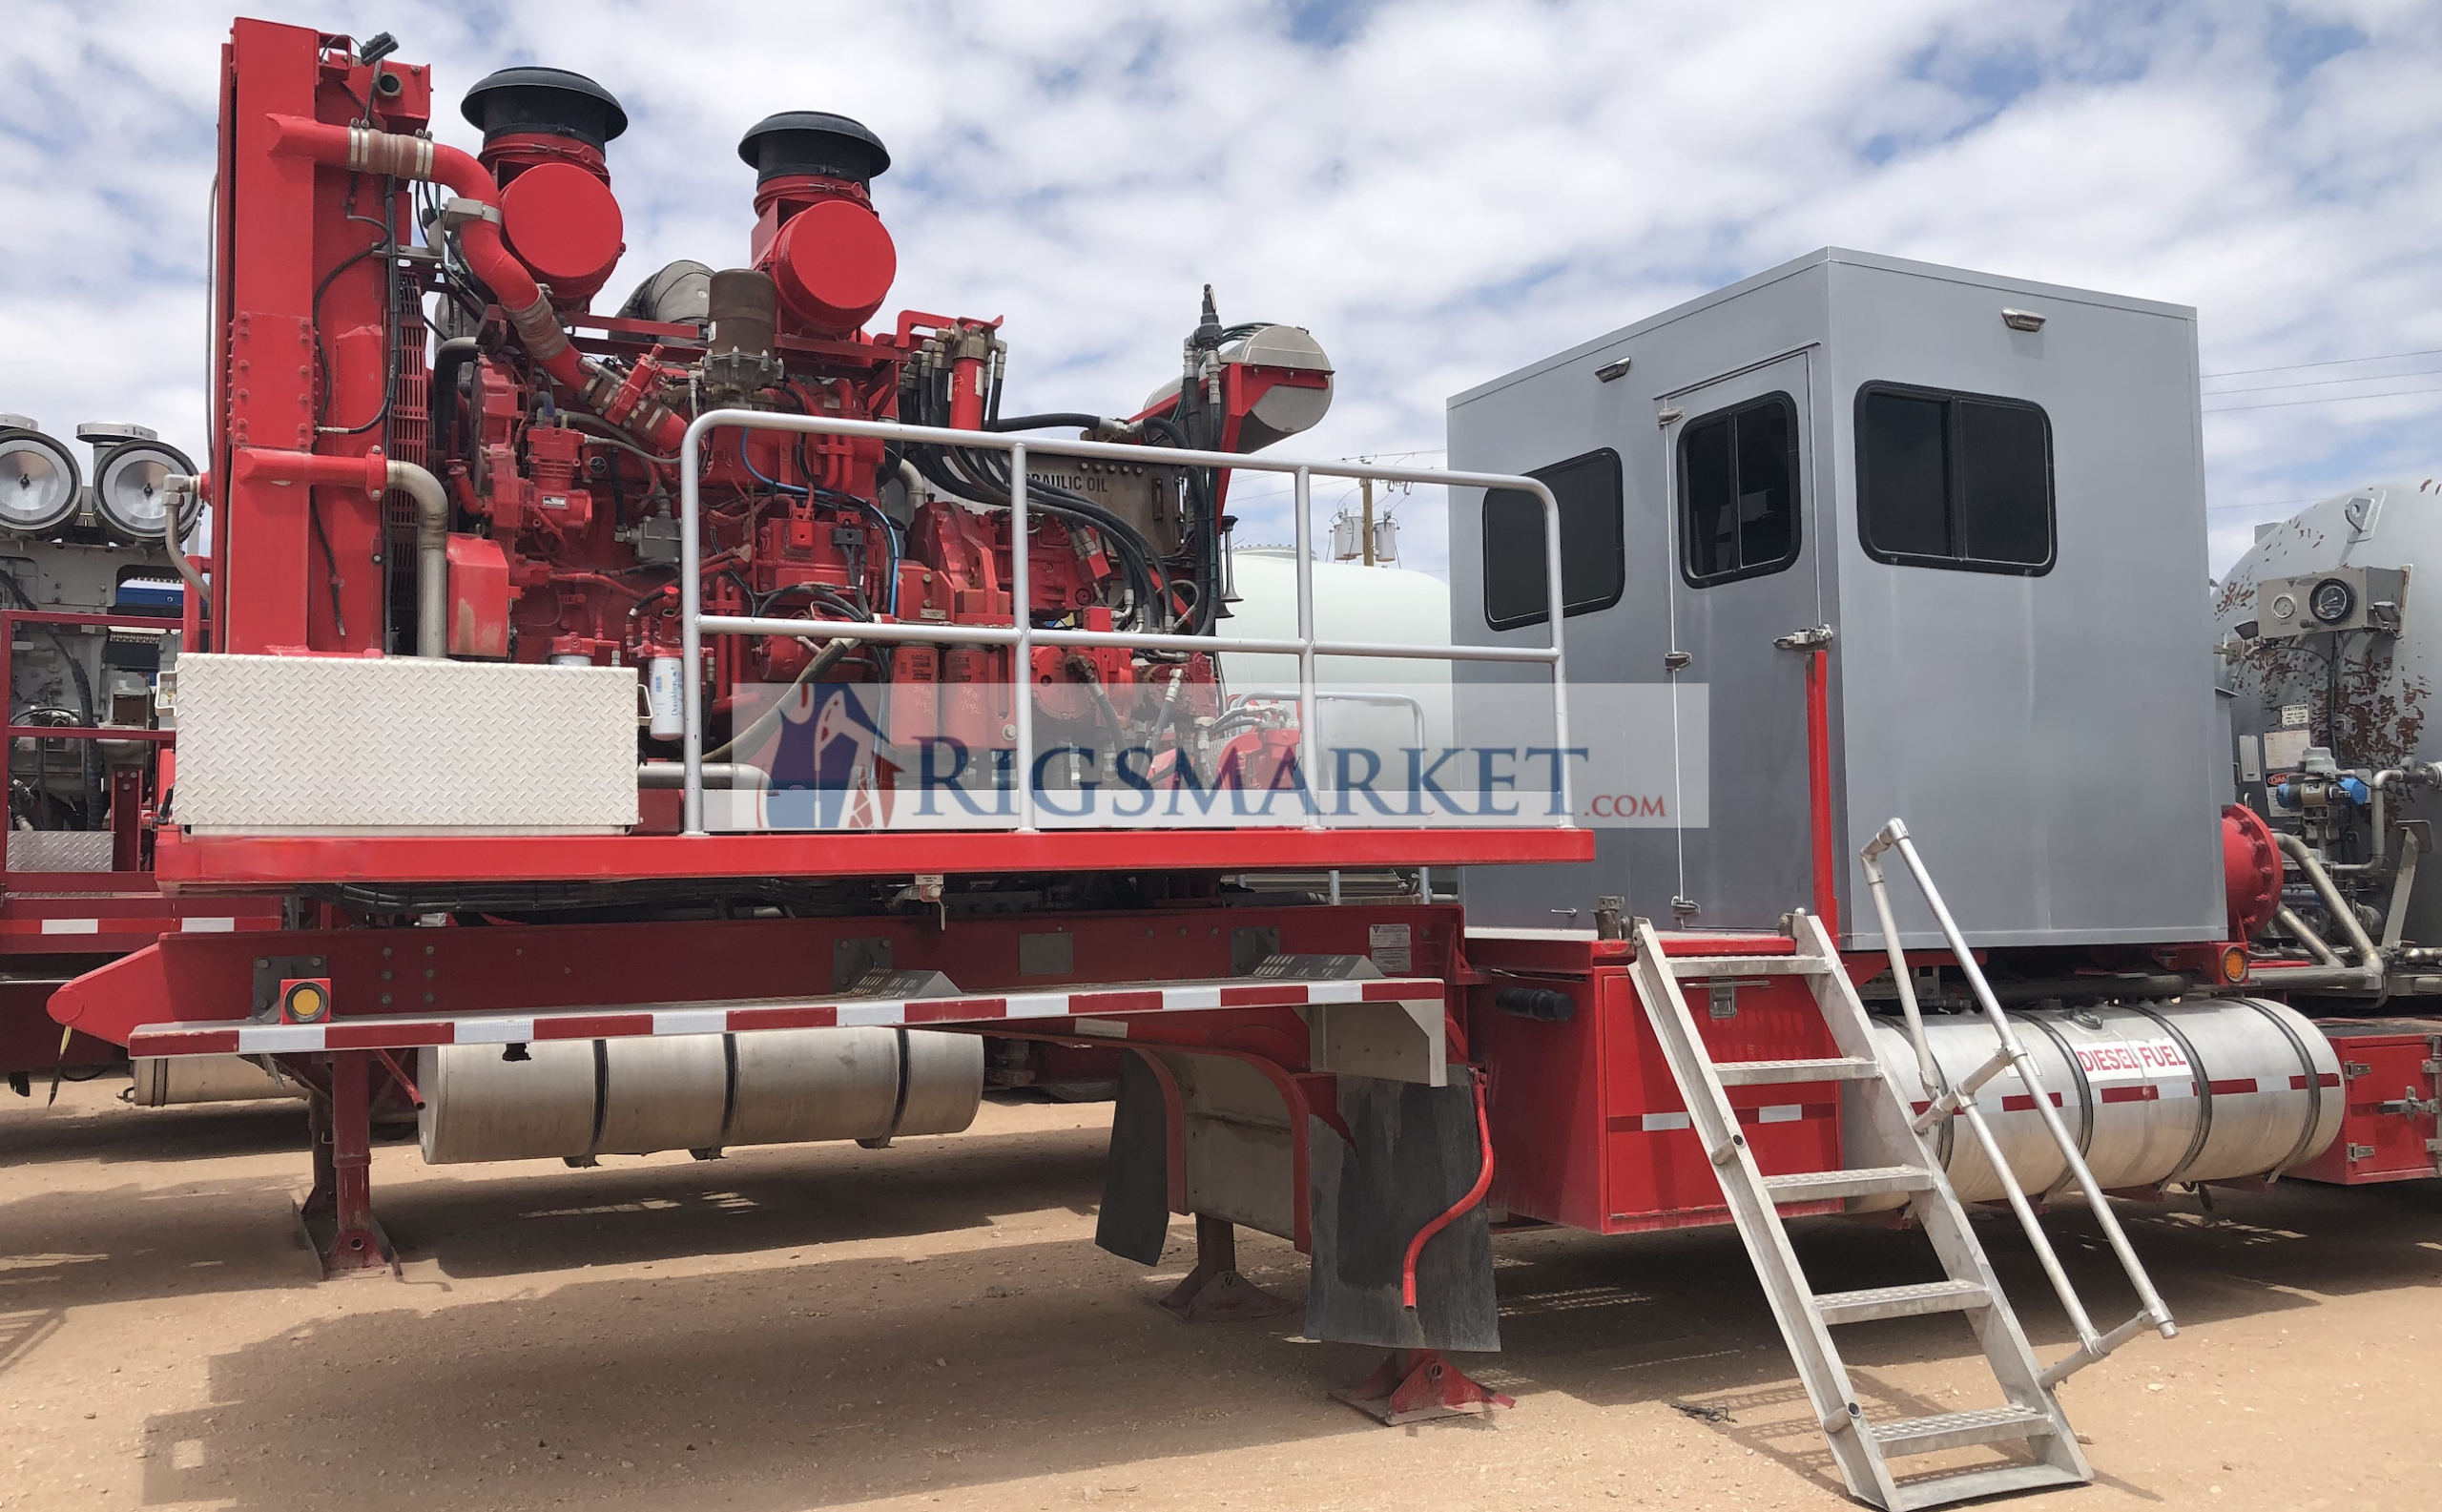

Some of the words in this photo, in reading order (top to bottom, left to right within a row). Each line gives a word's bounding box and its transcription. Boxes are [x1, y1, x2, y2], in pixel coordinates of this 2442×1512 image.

[1087, 477, 1108, 492] OIL
[2076, 1048, 2139, 1071] DIESEL
[2138, 1046, 2186, 1067] FUEL
